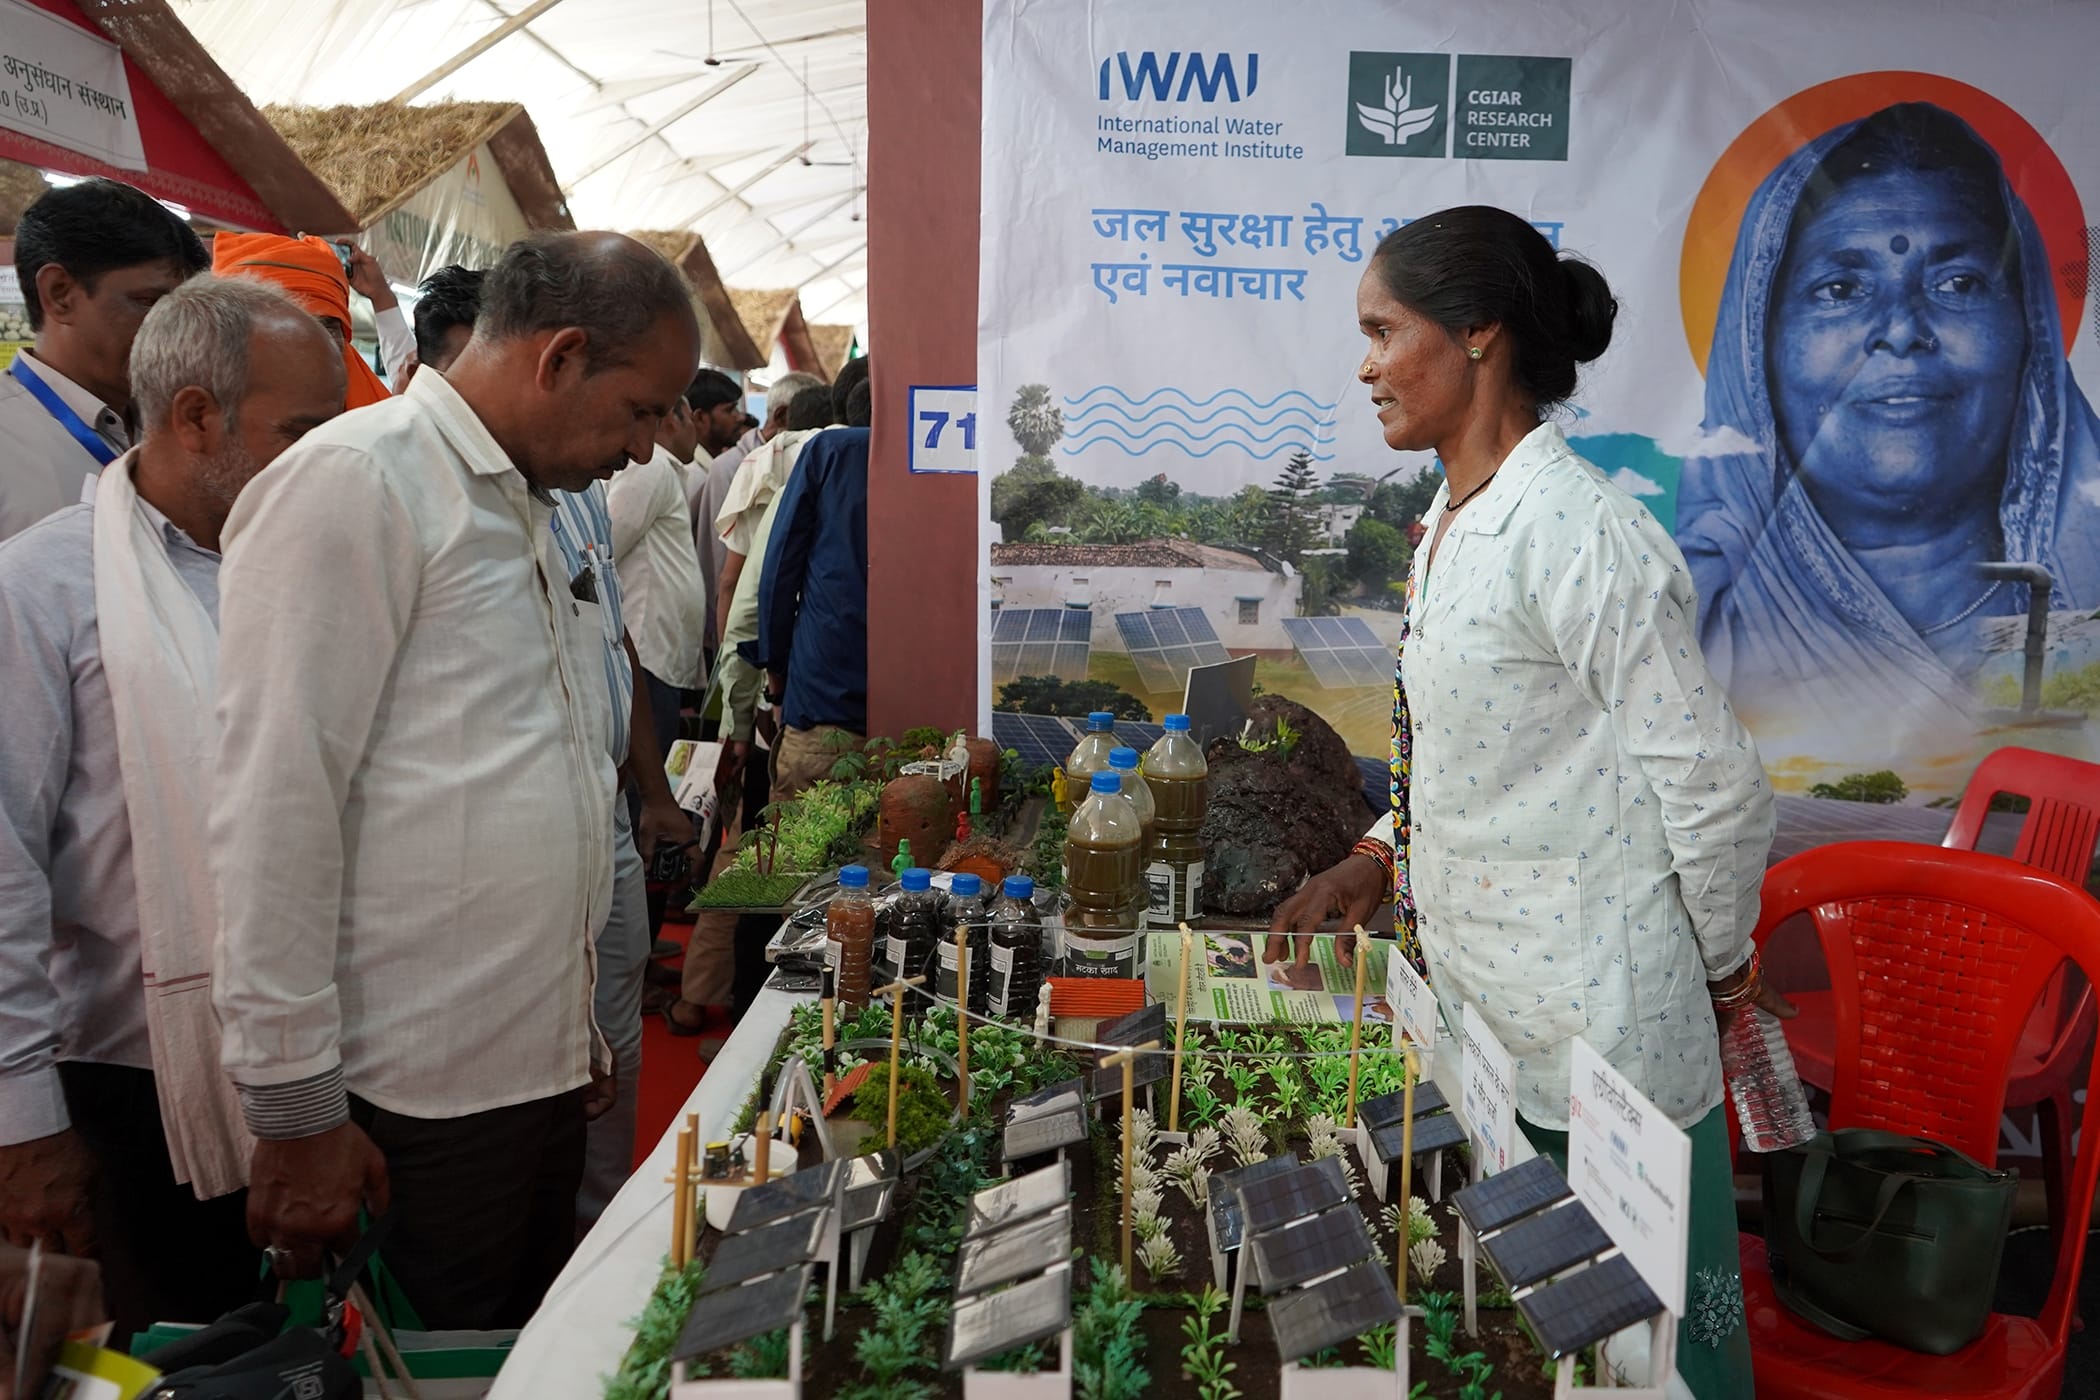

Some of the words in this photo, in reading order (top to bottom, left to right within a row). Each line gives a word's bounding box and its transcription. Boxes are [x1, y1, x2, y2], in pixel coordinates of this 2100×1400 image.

[3, 55, 72, 100] अनुसंधान
[75, 82, 127, 120] संस्थान
[1098, 50, 1259, 104] IWMI
[1468, 90, 1522, 106] CGIAR
[1097, 114, 1220, 136] International
[1224, 117, 1283, 137] Water
[1467, 111, 1553, 128] RESEARCH
[1097, 137, 1218, 161] Management
[1224, 141, 1304, 160] Institute
[1466, 132, 1531, 148] CENTER
[1091, 207, 1170, 242] जल
[1179, 210, 1294, 258] सुरक्षा
[1302, 202, 1364, 261] हेतु
[1091, 252, 1150, 305] एवं
[1161, 263, 1308, 302] नवाचार
[919, 411, 976, 449] 71
[1075, 964, 1098, 975] मटका
